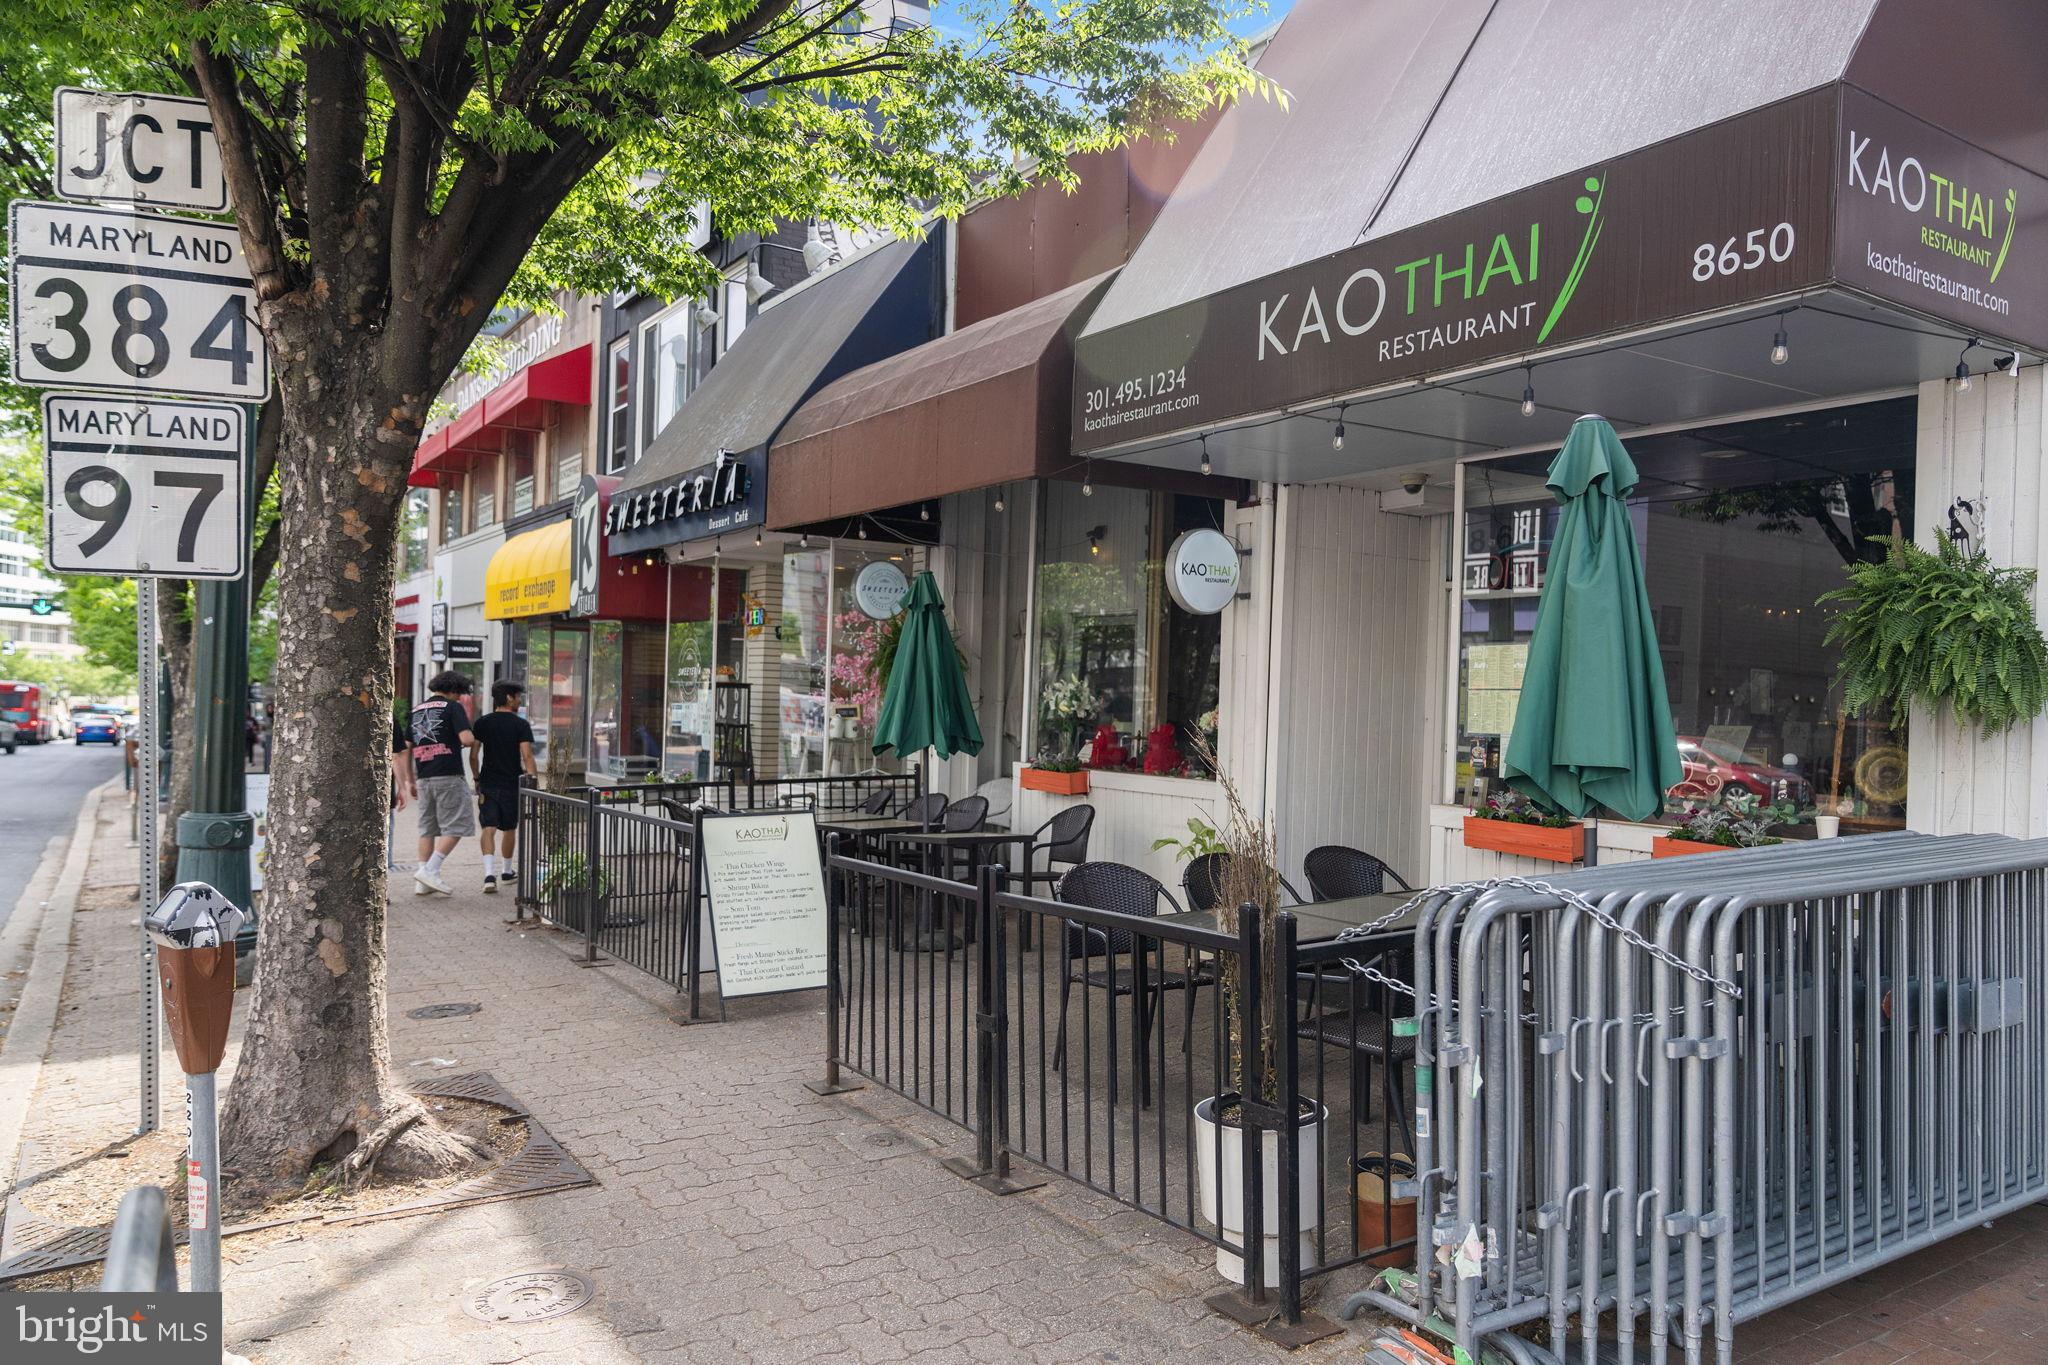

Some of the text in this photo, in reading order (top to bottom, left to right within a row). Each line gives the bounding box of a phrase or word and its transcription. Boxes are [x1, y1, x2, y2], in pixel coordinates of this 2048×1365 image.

[69, 109, 214, 190] JCT
[49, 221, 233, 264] MARYLAND
[1692, 222, 1795, 282] 8650
[1921, 226, 1992, 268] RESTAURANT
[1867, 242, 2010, 315] kaothairestaurant.com
[30, 277, 254, 386] 384
[1379, 302, 1537, 362] RESTAURANT
[1085, 366, 1187, 413] 301.495.1234
[58, 408, 232, 442] MARYLAND
[1084, 393, 1200, 432] kaothairestaurant.com
[64, 464, 224, 563] 97
[604, 450, 742, 536] SWEETERIA
[708, 515, 730, 530] Dessert
[499, 577, 556, 603] record exchange
[740, 861, 765, 869] Chicken
[755, 950, 776, 958] Mango
[781, 963, 804, 972] Custard
